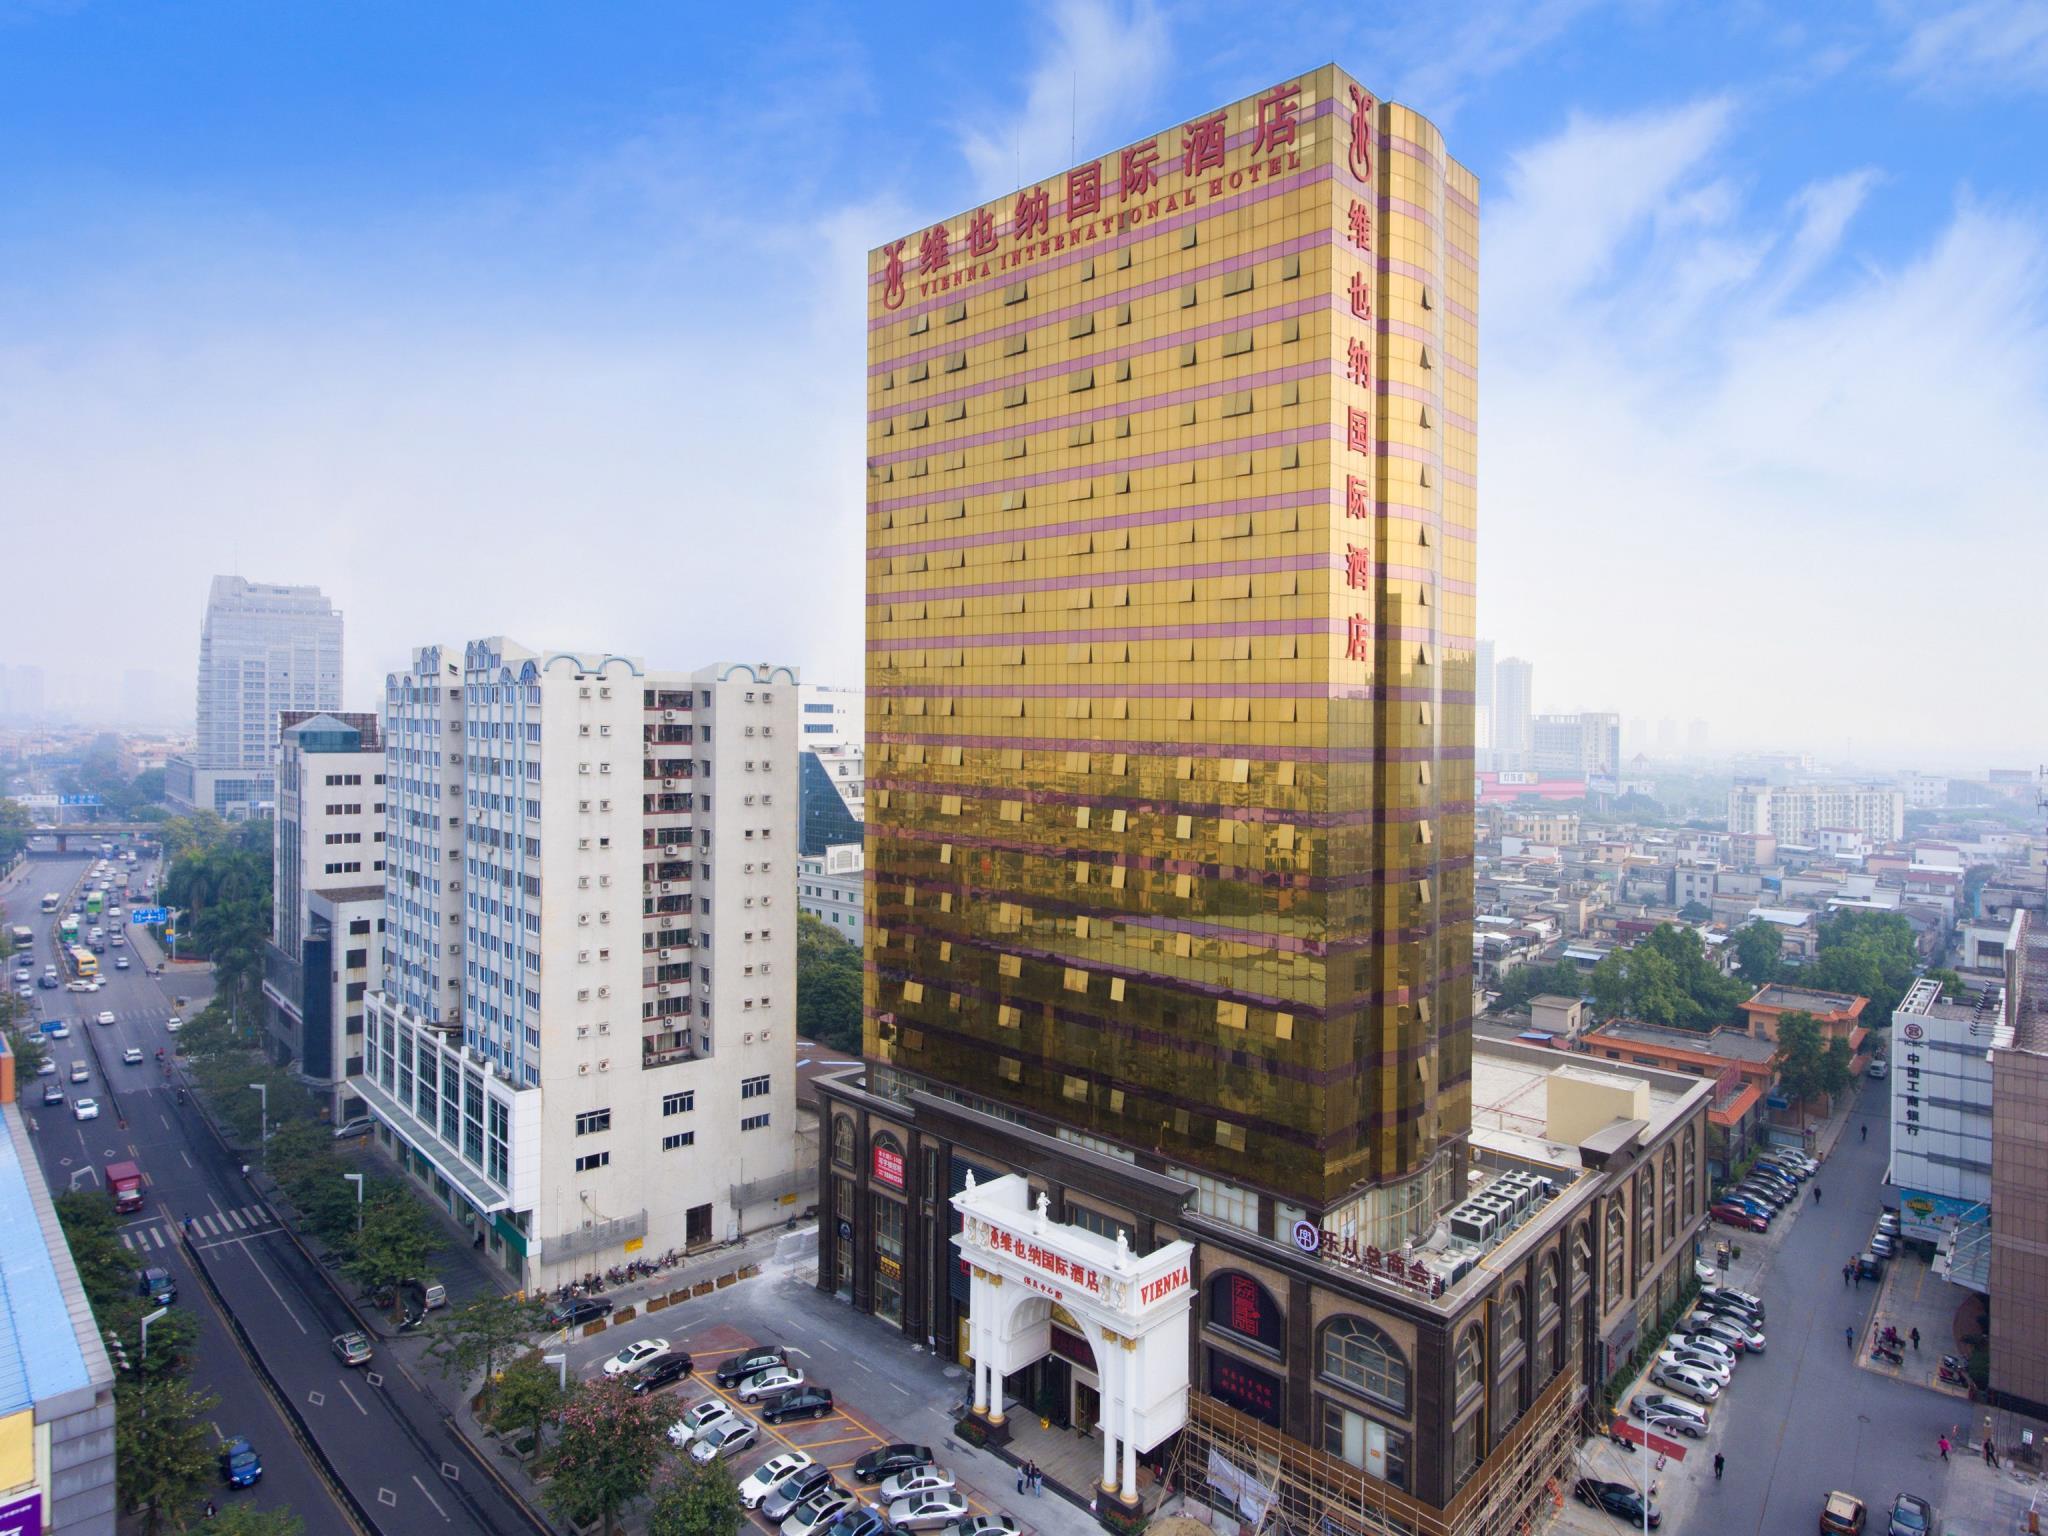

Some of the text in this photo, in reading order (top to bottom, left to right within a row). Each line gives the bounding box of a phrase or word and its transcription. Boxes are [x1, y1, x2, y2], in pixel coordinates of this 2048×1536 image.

[919, 83, 1301, 275] 维也纳国际酒店
[920, 151, 1301, 297] VIENNA INTERNATIONAL HOTEL
[1346, 199, 1371, 662] 维也纳国际酒店
[1907, 1053, 1920, 1136] 中国工商银行
[1000, 1231, 1099, 1293] 维也纳国际酒店
[1141, 1266, 1189, 1305] VIENNA
